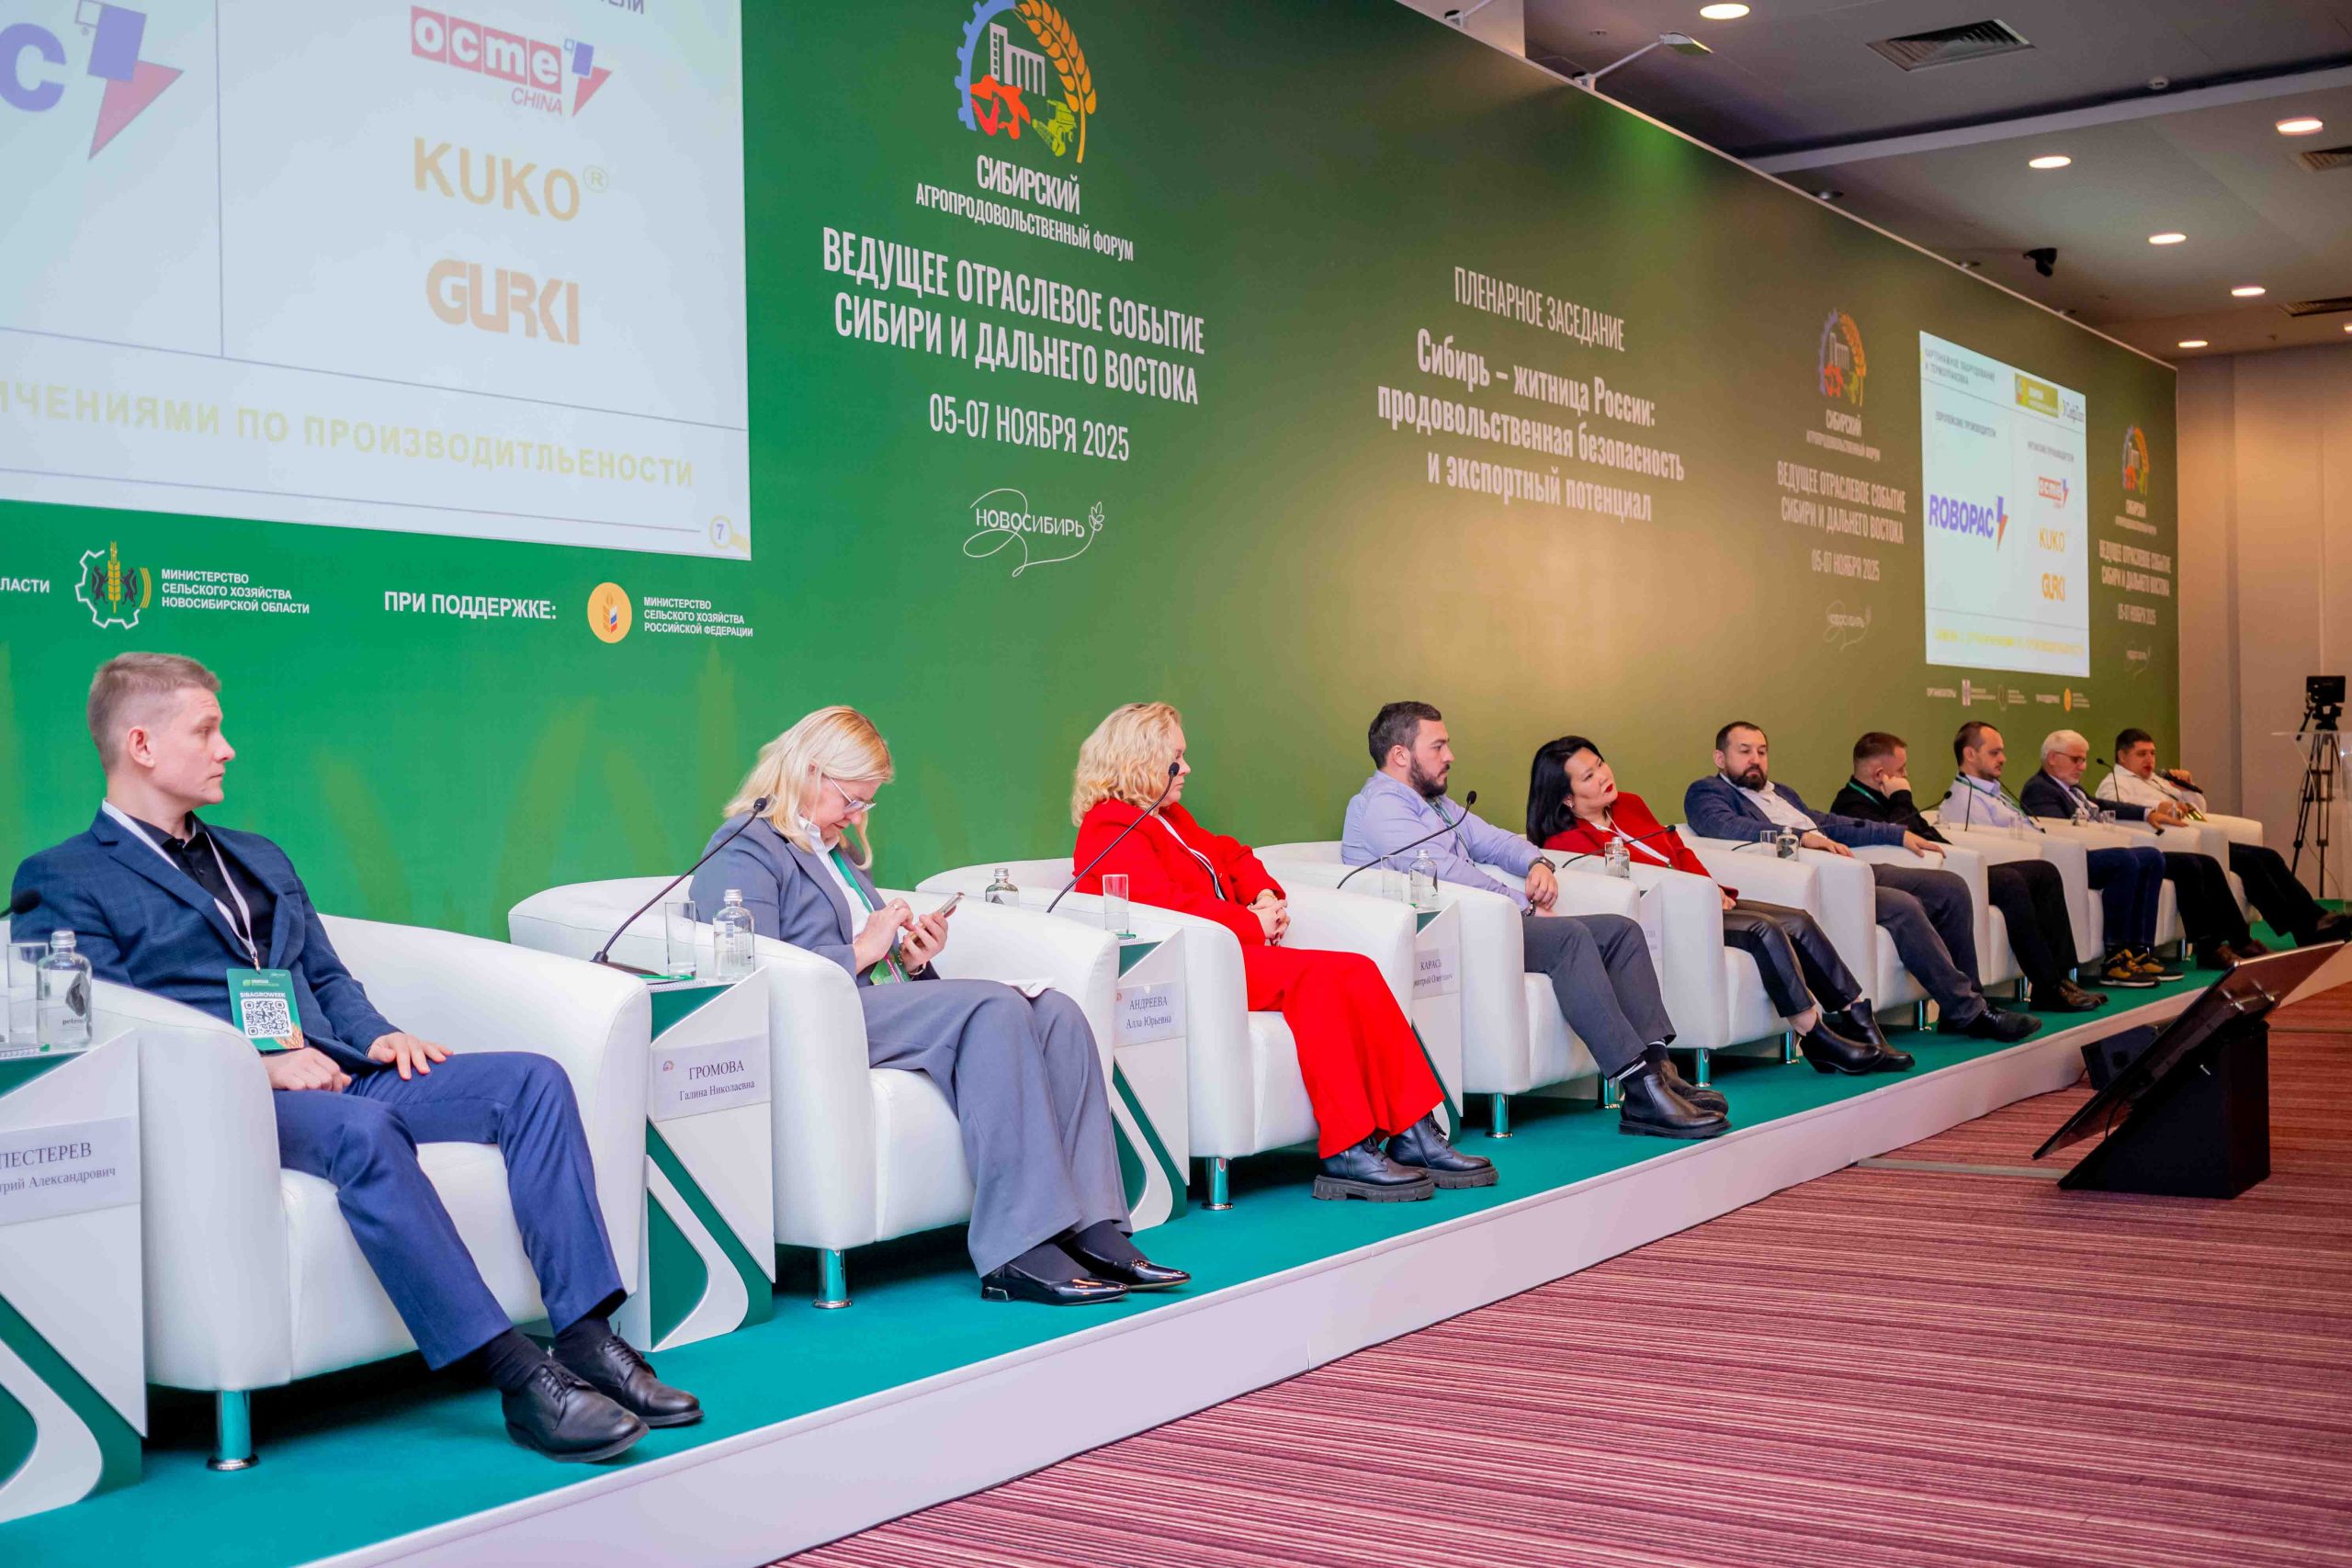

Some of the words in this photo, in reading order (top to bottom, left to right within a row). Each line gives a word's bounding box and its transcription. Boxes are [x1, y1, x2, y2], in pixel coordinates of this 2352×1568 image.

[413, 16, 560, 85] ocme
[511, 87, 562, 115] CHINA
[977, 154, 1080, 215] СИБИРСКИЙ
[916, 183, 1091, 250] АГРОПРОДОВОЛЬСТВЕННЫЙ
[1093, 231, 1134, 262] ФОРУМ
[426, 258, 580, 345] GURKI
[823, 227, 949, 299] ВЕДУЩЕЕ
[956, 260, 1102, 332] ОТРАСЛЕВОЕ
[1109, 297, 1204, 355] СОБЫТИЕ
[1454, 265, 1544, 328] ПЛЕНАРНОЕ
[1547, 296, 1624, 352] ЗАСЕДАНИЕ
[835, 292, 942, 355] СИБИРИ
[951, 316, 967, 359] И
[975, 322, 1097, 385] ДАЛЬНЕГО
[1104, 349, 1198, 405] ВОСТОКА
[1418, 328, 1490, 392] Сибирь
[1514, 365, 1589, 417] житница
[1595, 376, 1656, 427] России:
[236, 409, 288, 442] ПО
[930, 393, 989, 439] 05-07
[996, 404, 1077, 454] НОЯБРЯ
[1082, 420, 1129, 461] 2025
[1378, 385, 1573, 458] продовольственная
[1578, 422, 1685, 481] безопасность
[1446, 456, 1560, 505] экспортный
[1566, 479, 1651, 524] потенциал
[976, 508, 1085, 537] НОВОСИБИРЬ
[1928, 494, 1994, 539] ROBOPAC
[716, 523, 724, 540] 7
[162, 569, 249, 584] МИНИСТЕРСТВО
[162, 582, 228, 598] СЕЛЬСКОГО
[230, 585, 292, 600] ХОЗЯЙСТВА
[162, 596, 259, 612] НОВОСИБИРСКОЙ
[261, 600, 310, 614] ОБЛАСТИ
[384, 591, 425, 613] ПРИ
[432, 593, 557, 620] ПОДДЕРЖКЕ:
[644, 596, 711, 610] МИНИСТЕРСТВО
[644, 609, 695, 622] СЕЛЬСКОГО
[696, 611, 744, 625] ХОЗЯЙСТВА
[644, 621, 702, 635] РОССИЙСКОЙ
[704, 625, 753, 637] ФЕДЕРАЦИИ
[1129, 997, 1168, 1010] АНДРЕЕВА
[689, 1059, 744, 1080] ГРОМОВА
[680, 1089, 707, 1101] Галина
[709, 1080, 755, 1096] Николаевна
[28, 1168, 116, 1190] Александрович
